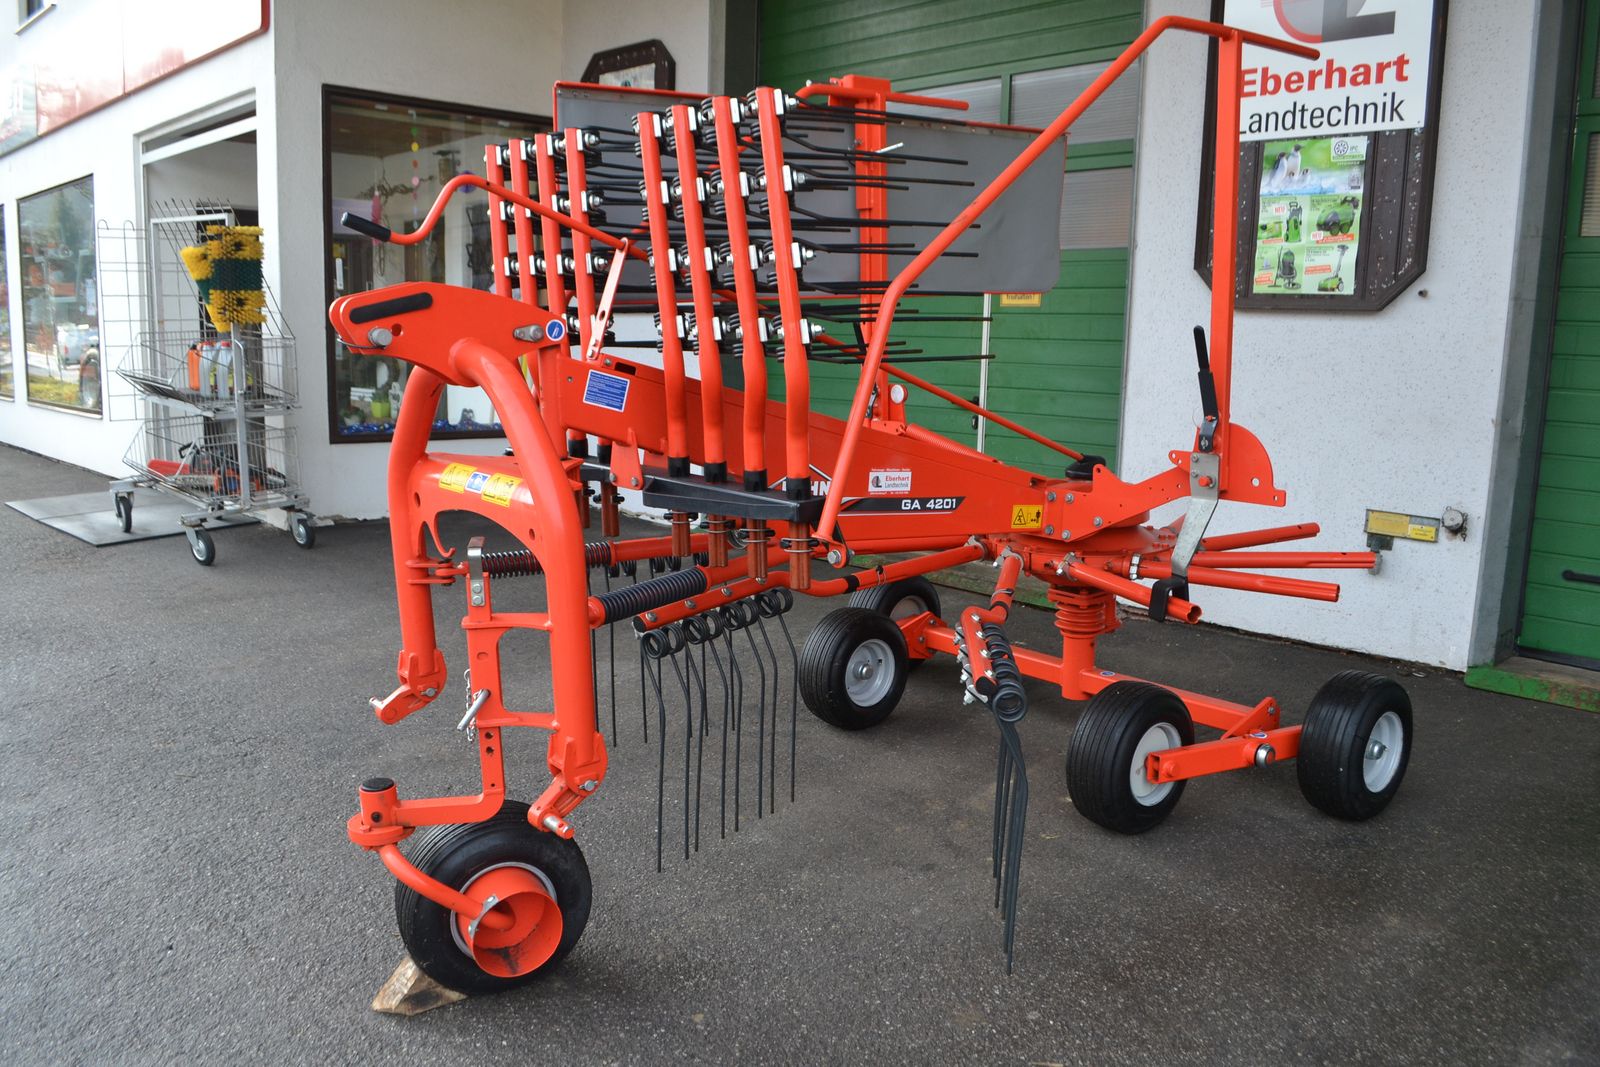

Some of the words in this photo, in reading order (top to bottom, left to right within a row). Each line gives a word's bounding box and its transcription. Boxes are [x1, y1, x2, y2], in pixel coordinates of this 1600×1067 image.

[1241, 53, 1409, 98] Eberhart
[1240, 91, 1405, 134] andtechnik
[901, 499, 921, 510] GA
[926, 498, 956, 510] 4201
